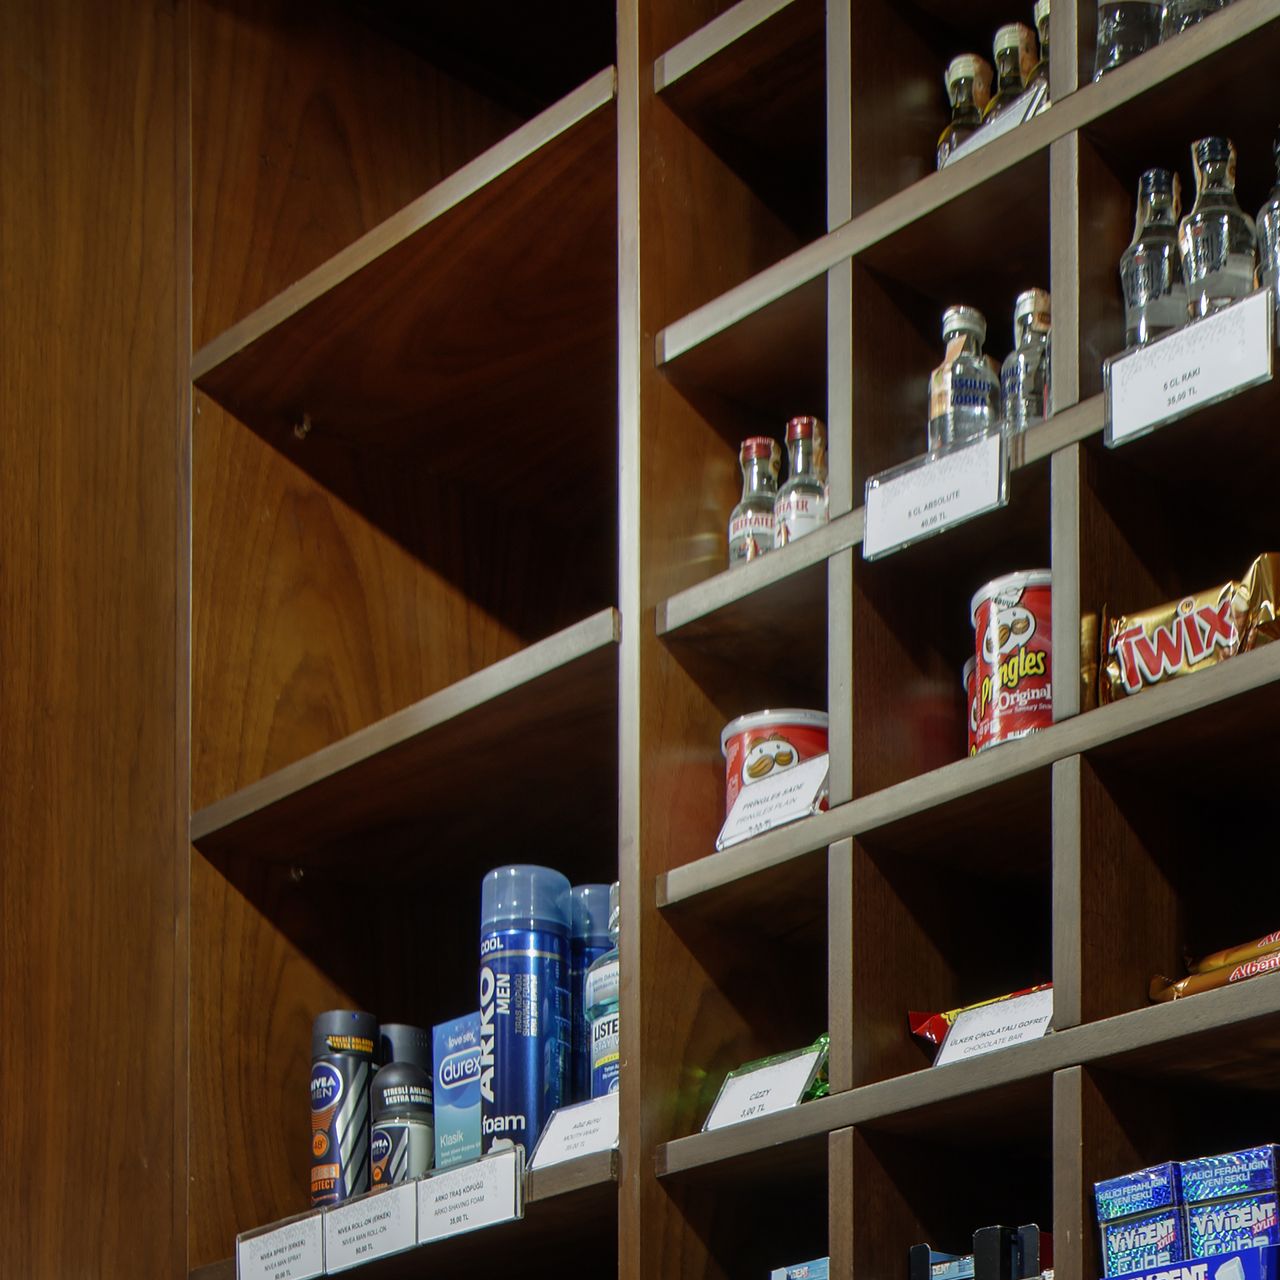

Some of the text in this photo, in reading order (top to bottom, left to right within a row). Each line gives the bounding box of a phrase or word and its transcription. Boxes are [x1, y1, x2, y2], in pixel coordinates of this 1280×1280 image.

[998, 683, 1051, 706] Original
[481, 937, 503, 955] COOL
[497, 973, 511, 1015] MEN
[481, 966, 495, 1102] ARKO
[964, 1032, 1023, 1054] CHOCOLATE BAR
[442, 1056, 480, 1084] durex
[482, 1114, 525, 1135] foam
[440, 1132, 464, 1146] Klasik
[434, 1195, 484, 1217] ARKO SHAVING FOAM
